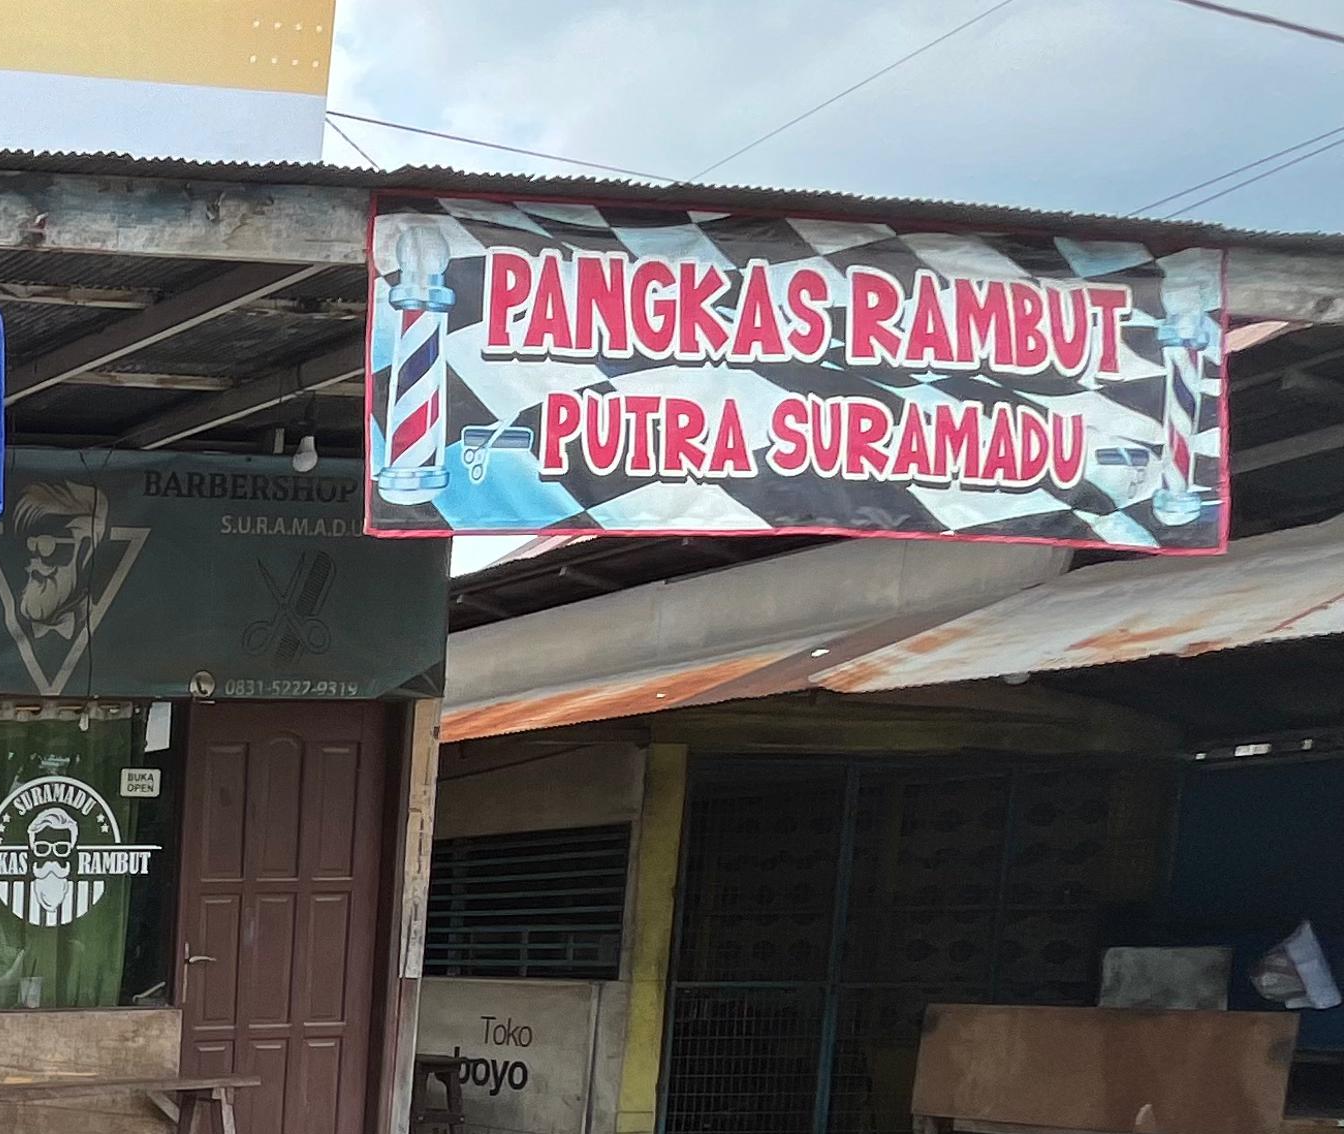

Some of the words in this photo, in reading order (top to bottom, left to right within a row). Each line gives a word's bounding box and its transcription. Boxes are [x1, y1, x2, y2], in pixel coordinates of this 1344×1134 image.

[486, 252, 830, 362] PANGKAS
[847, 268, 1134, 378] RAMBUT
[541, 394, 747, 476] PUTRA
[770, 398, 1088, 487] SURAMADU
[143, 470, 359, 503] BARBERSHOP
[127, 773, 154, 783] BUKA
[127, 783, 155, 794] OPEN
[13, 783, 97, 816] SURAMADU
[77, 851, 152, 875] RAMBUT
[480, 1015, 533, 1048] Toko
